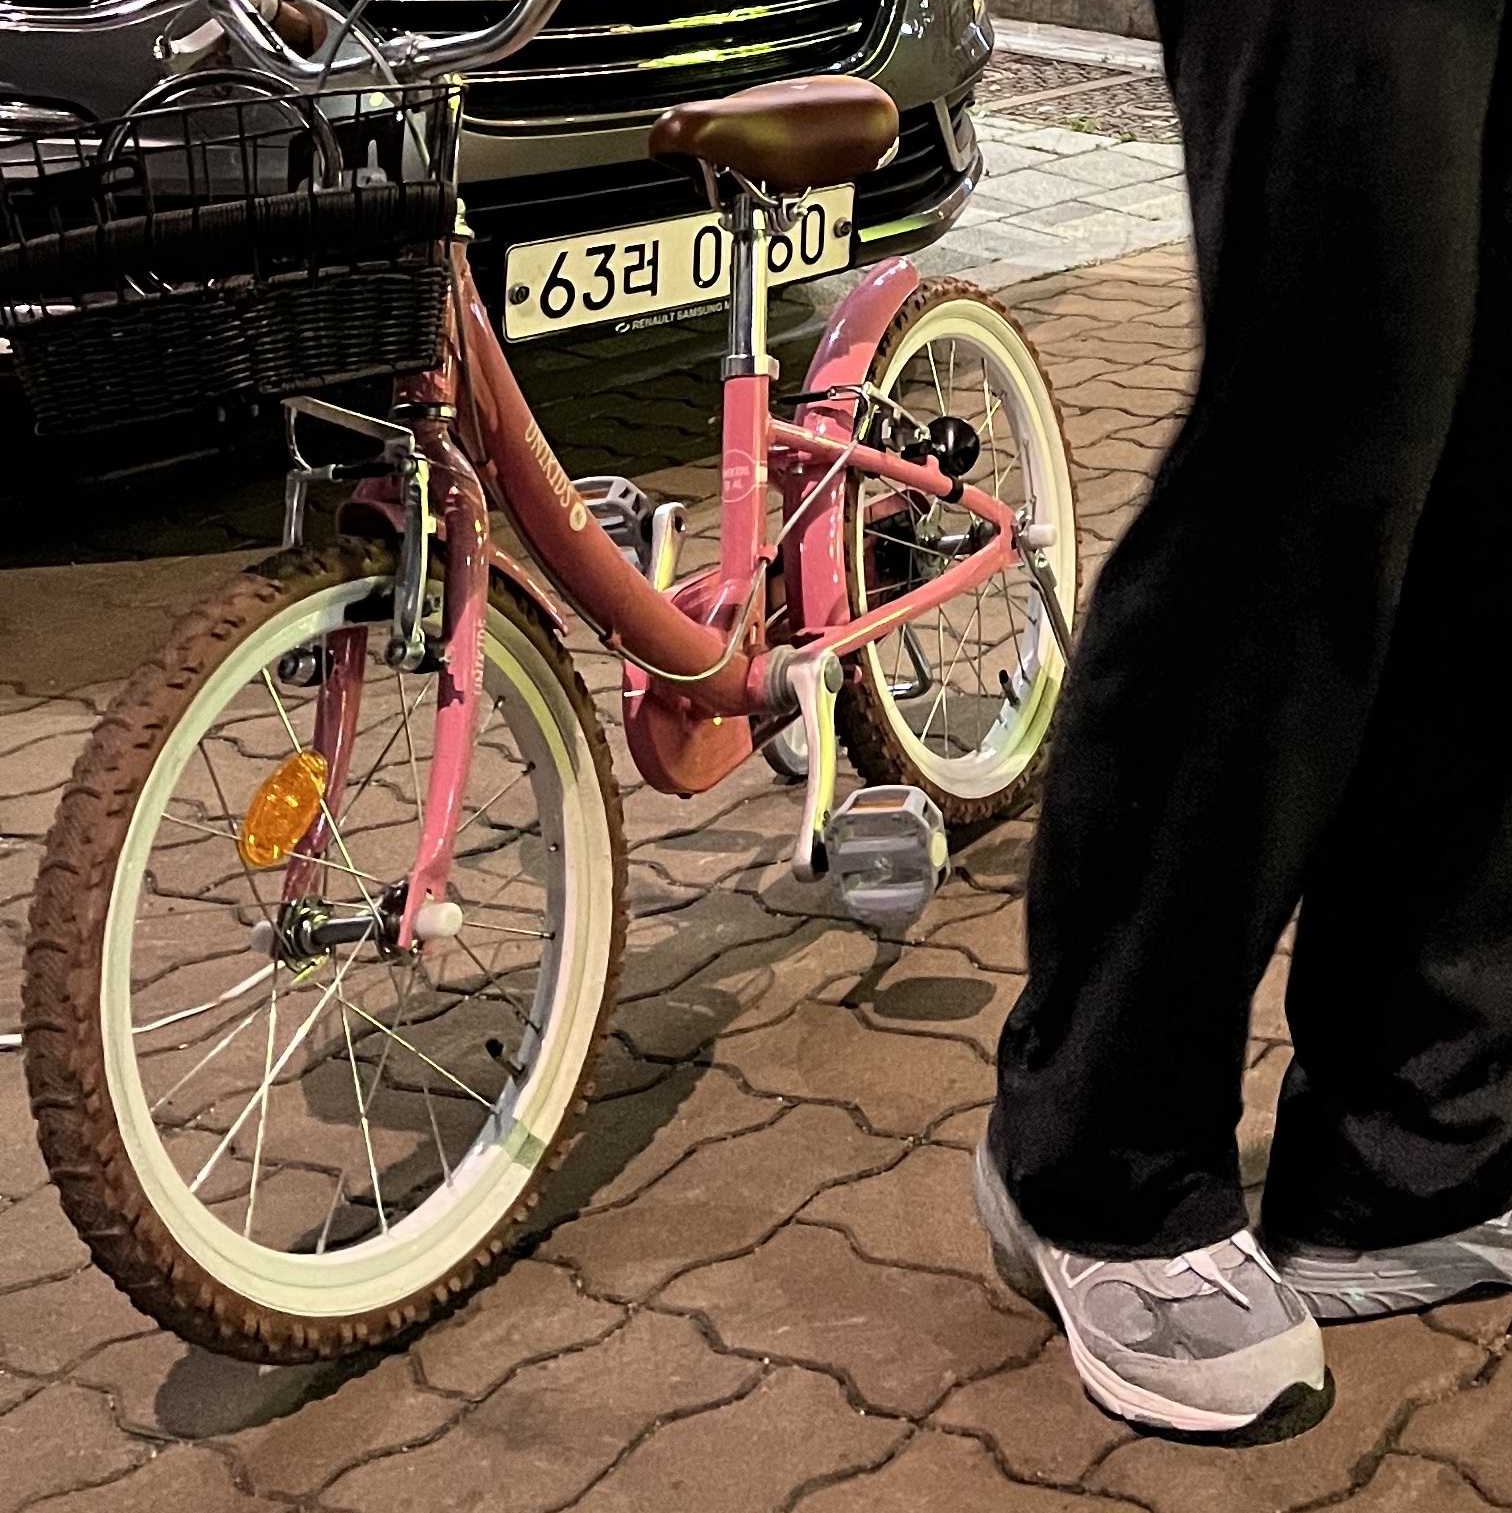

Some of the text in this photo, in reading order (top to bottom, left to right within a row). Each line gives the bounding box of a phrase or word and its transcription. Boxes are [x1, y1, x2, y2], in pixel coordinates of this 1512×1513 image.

[539, 203, 826, 319] 63러 060
[632, 312, 675, 330] RENAULT
[677, 302, 723, 321] SAMSUNG
